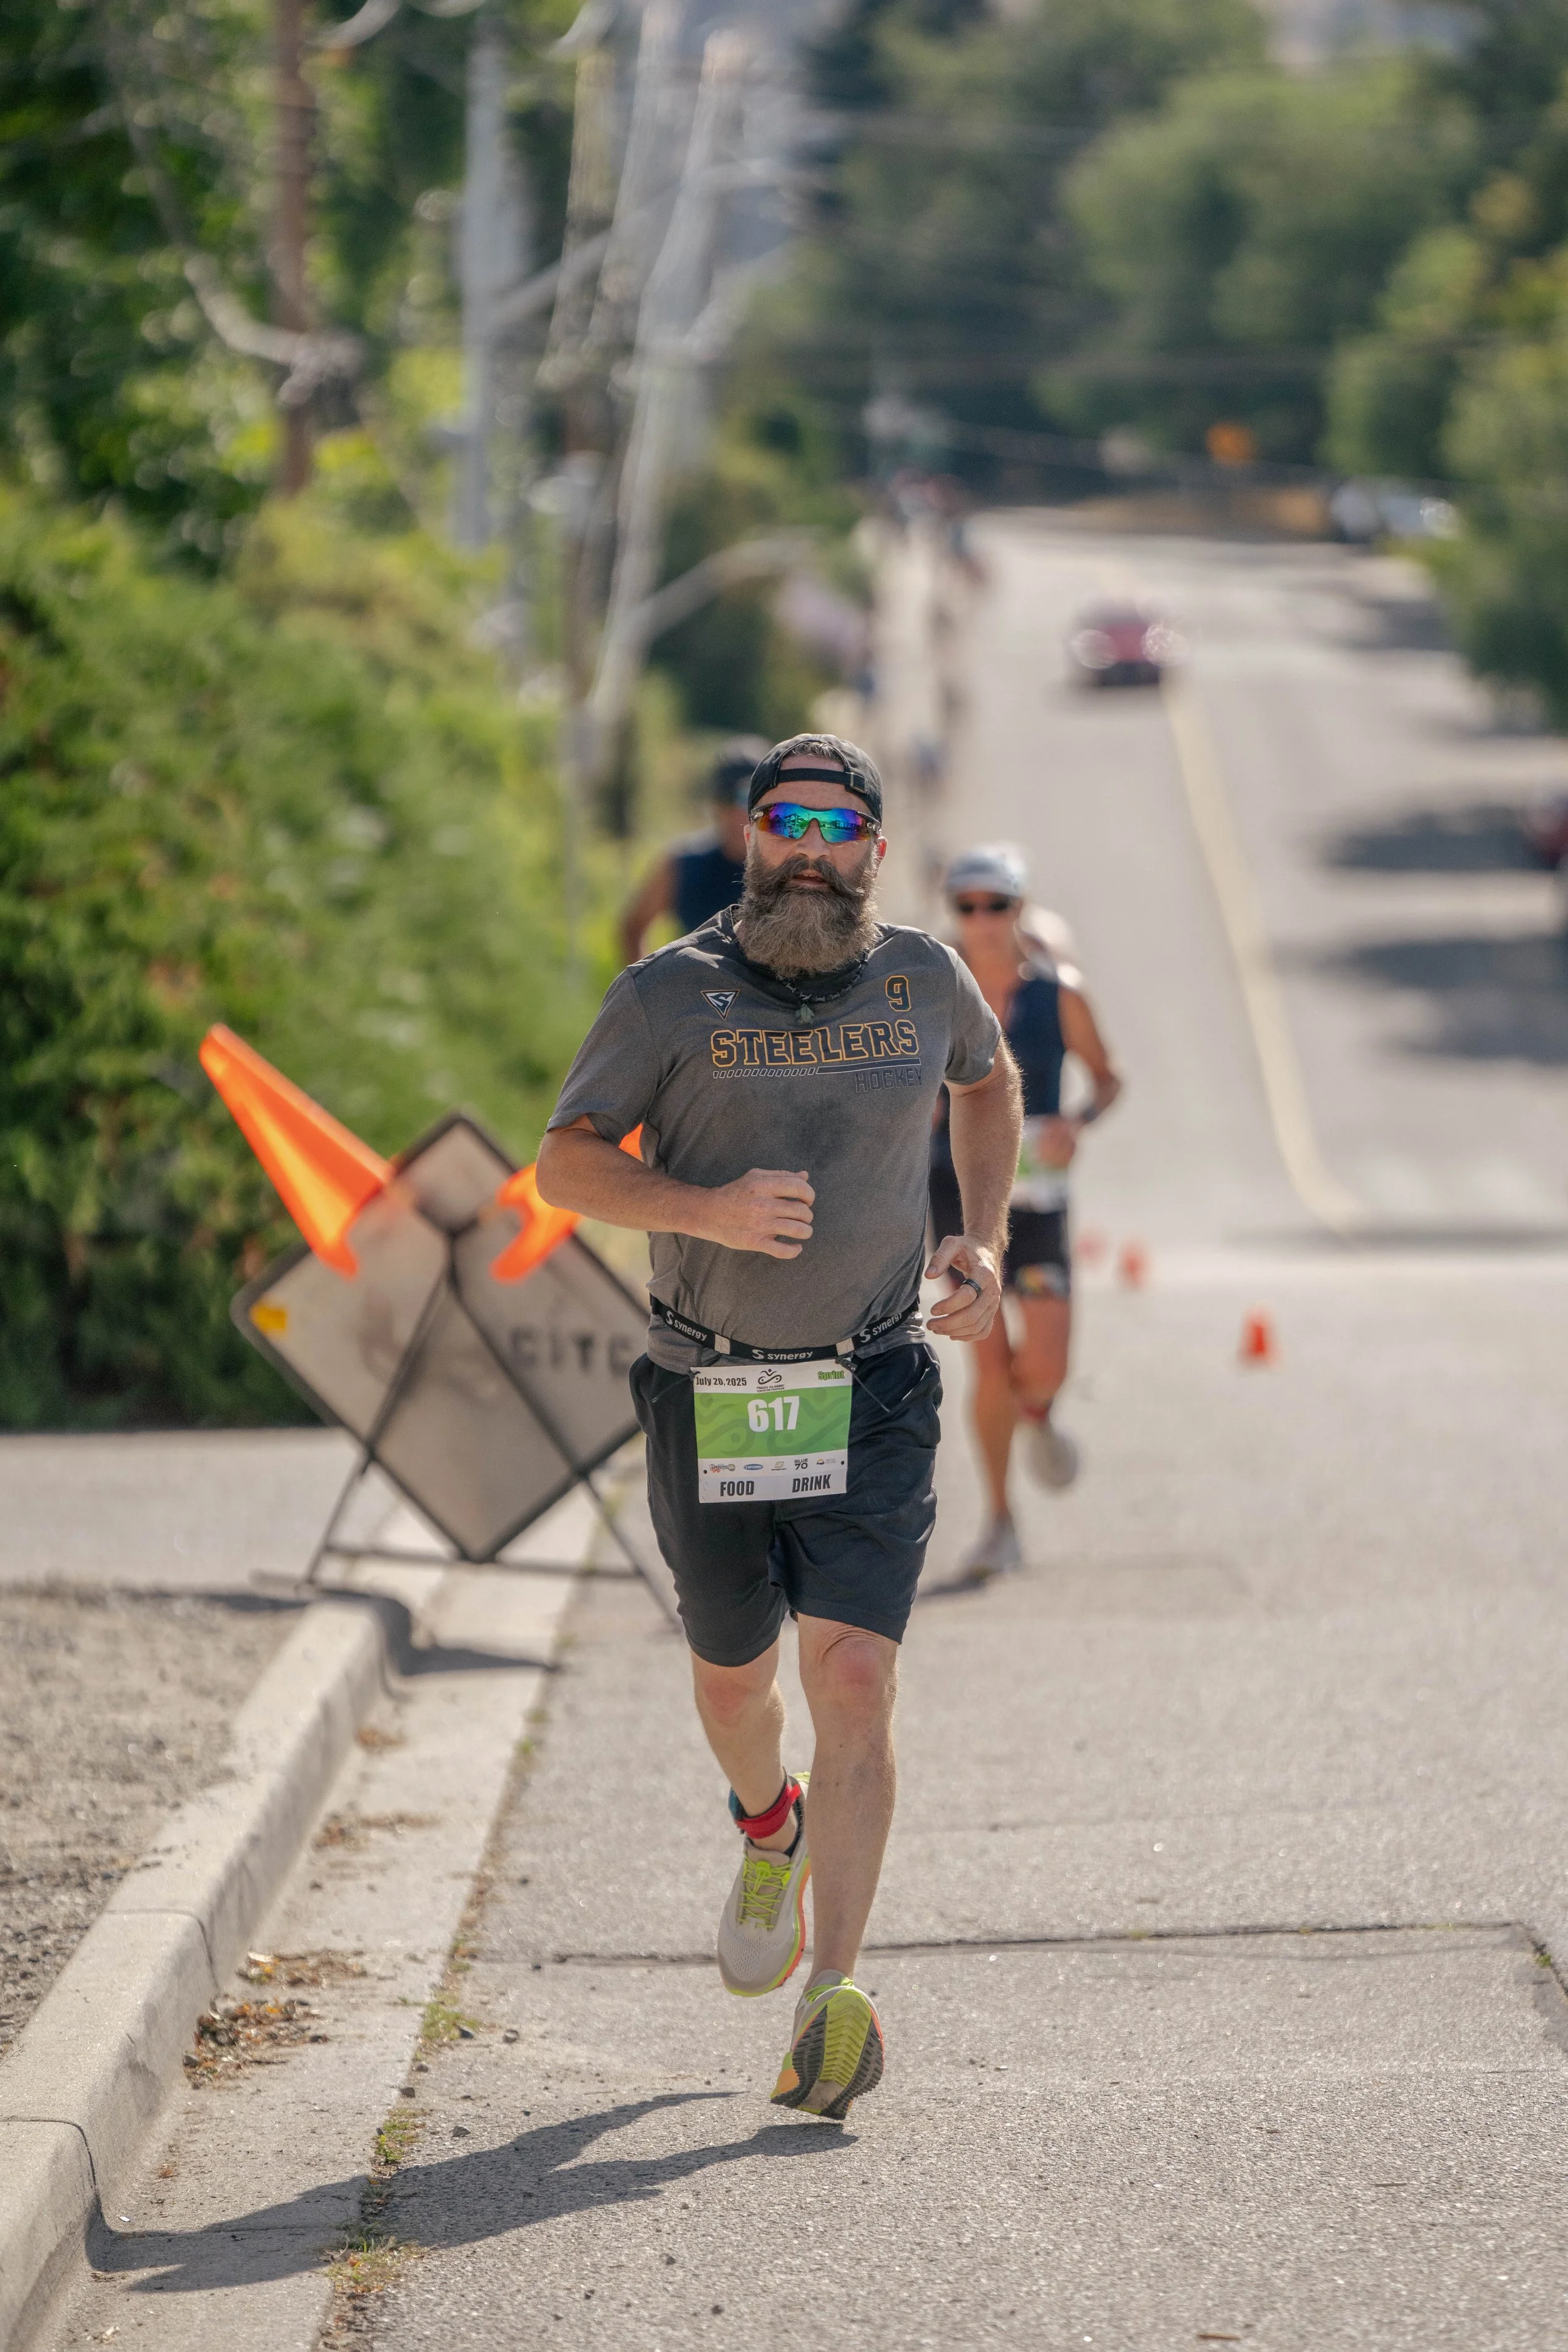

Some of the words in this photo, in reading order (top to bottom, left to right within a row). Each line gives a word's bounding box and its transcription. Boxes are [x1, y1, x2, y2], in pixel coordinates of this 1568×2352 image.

[885, 975, 912, 1012] 9
[710, 1019, 919, 1067] STEELERS
[855, 1067, 922, 1093] HOCKEY
[674, 1320, 707, 1341] synergy
[767, 1351, 813, 1360] synergy
[696, 1377, 711, 1386] July
[726, 1377, 747, 1386] 2025
[817, 1370, 845, 1380] Sprint
[747, 1396, 800, 1433] 617
[720, 1480, 755, 1496] FOOD
[792, 1475, 831, 1493] DRINK
